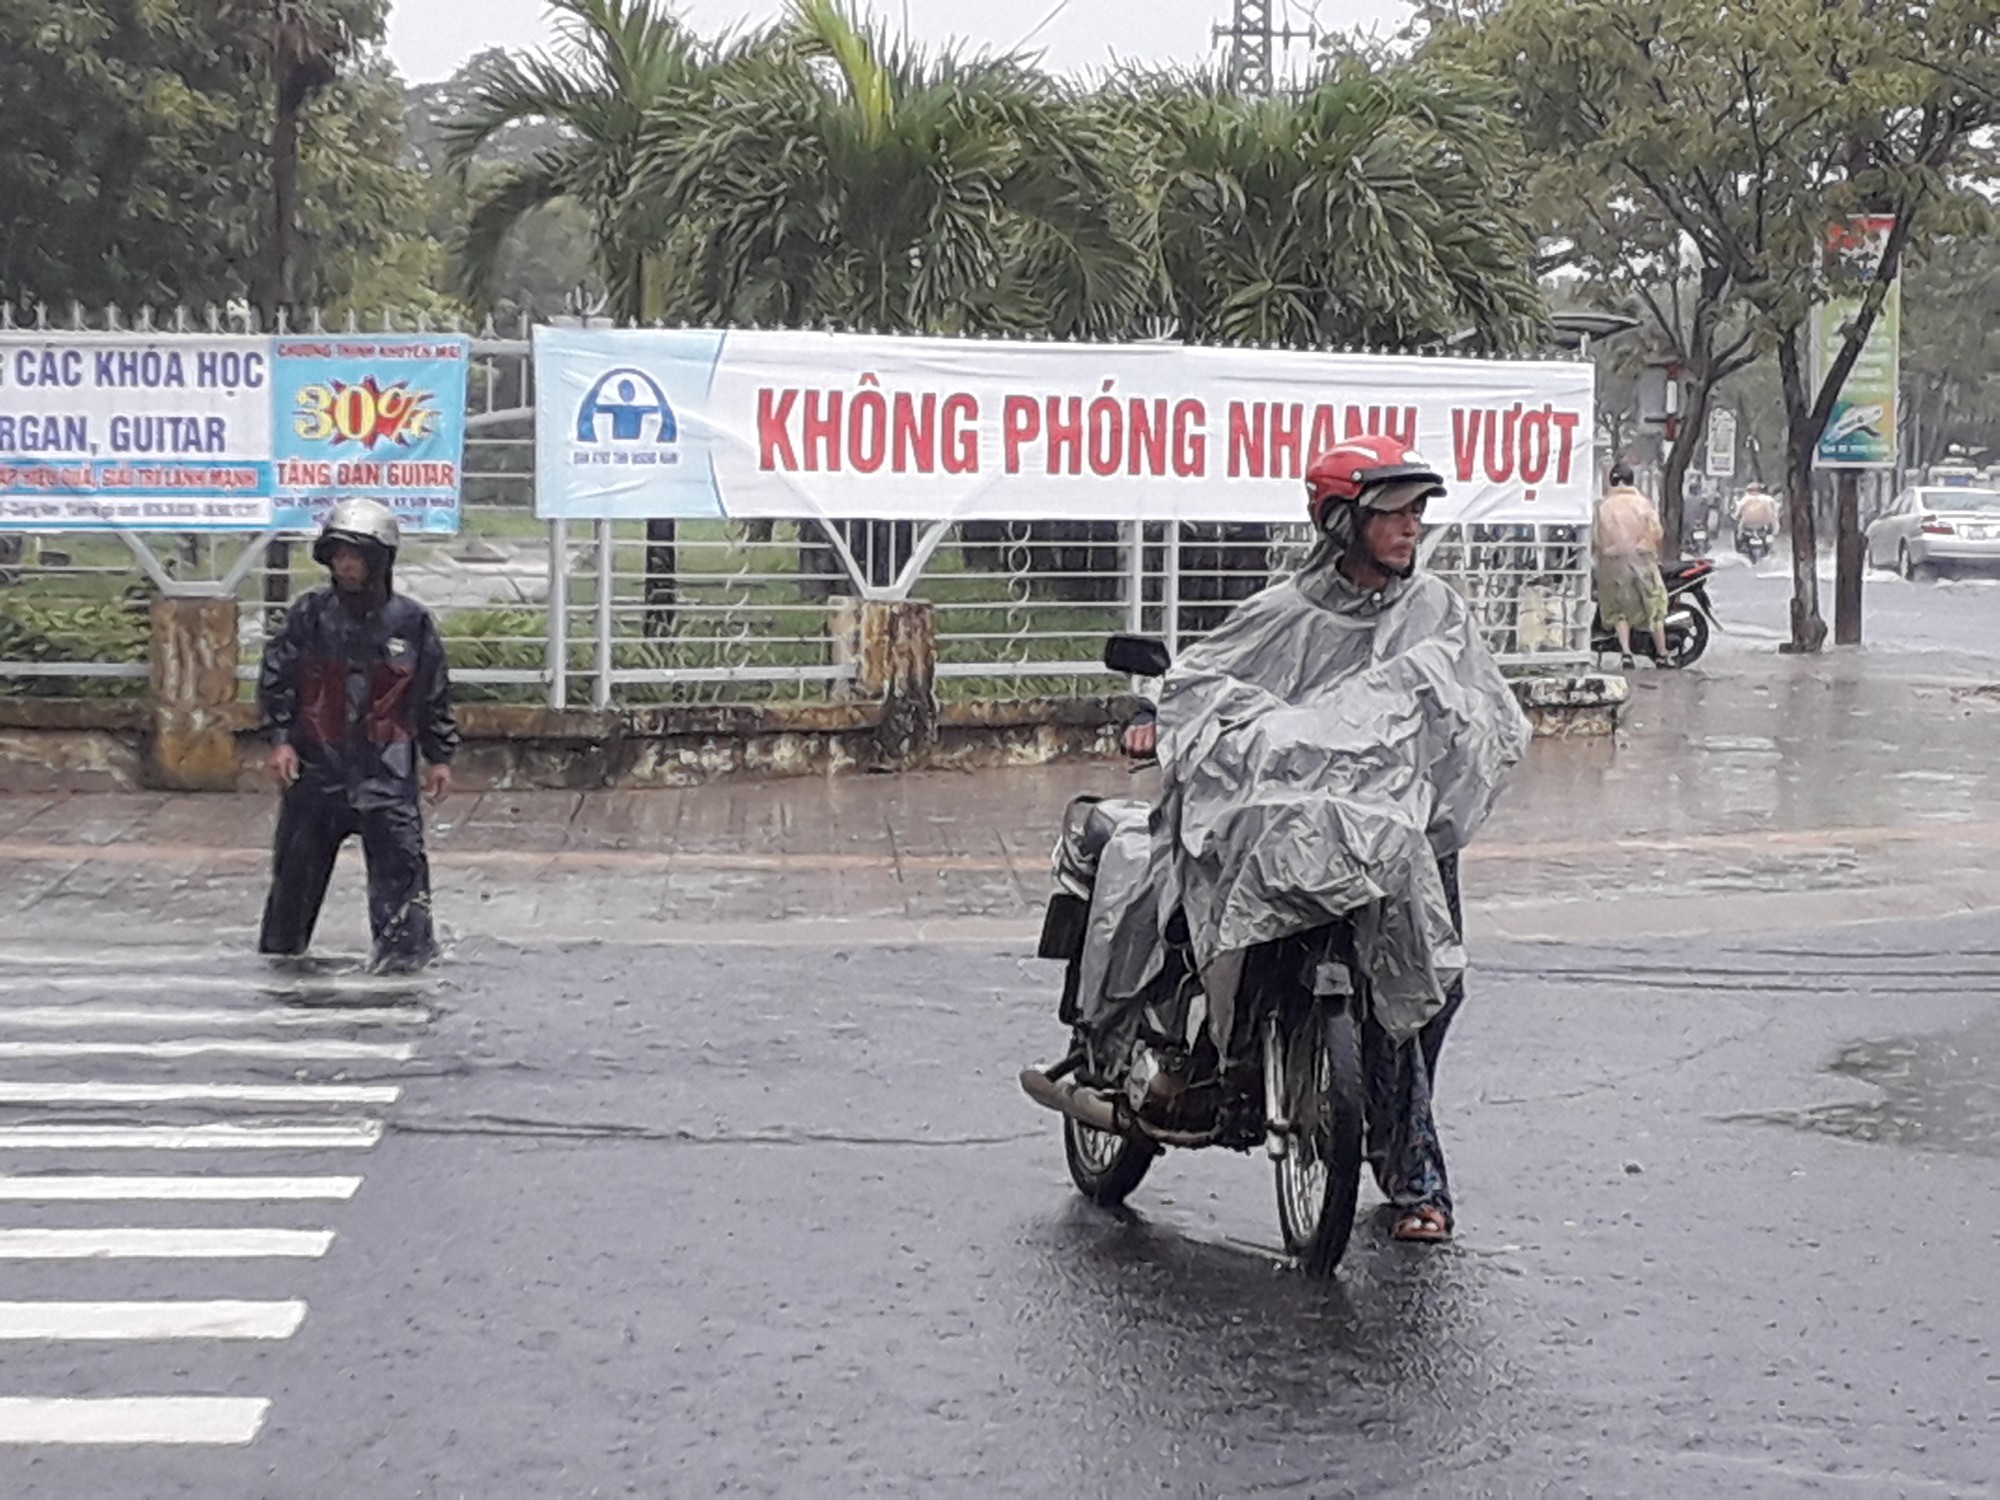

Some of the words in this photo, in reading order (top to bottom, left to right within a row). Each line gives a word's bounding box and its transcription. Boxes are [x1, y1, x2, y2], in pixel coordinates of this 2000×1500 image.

[15, 342, 83, 388] CÁC
[95, 343, 185, 388] KHÓA
[197, 350, 264, 397] HỌC
[110, 415, 226, 452] GUITAR
[294, 384, 437, 440] 30%
[757, 372, 979, 474] KHÔNG
[1003, 379, 1206, 477] PHÓNG
[1451, 402, 1580, 501] VƯỢT
[386, 462, 458, 488] GUITAR
